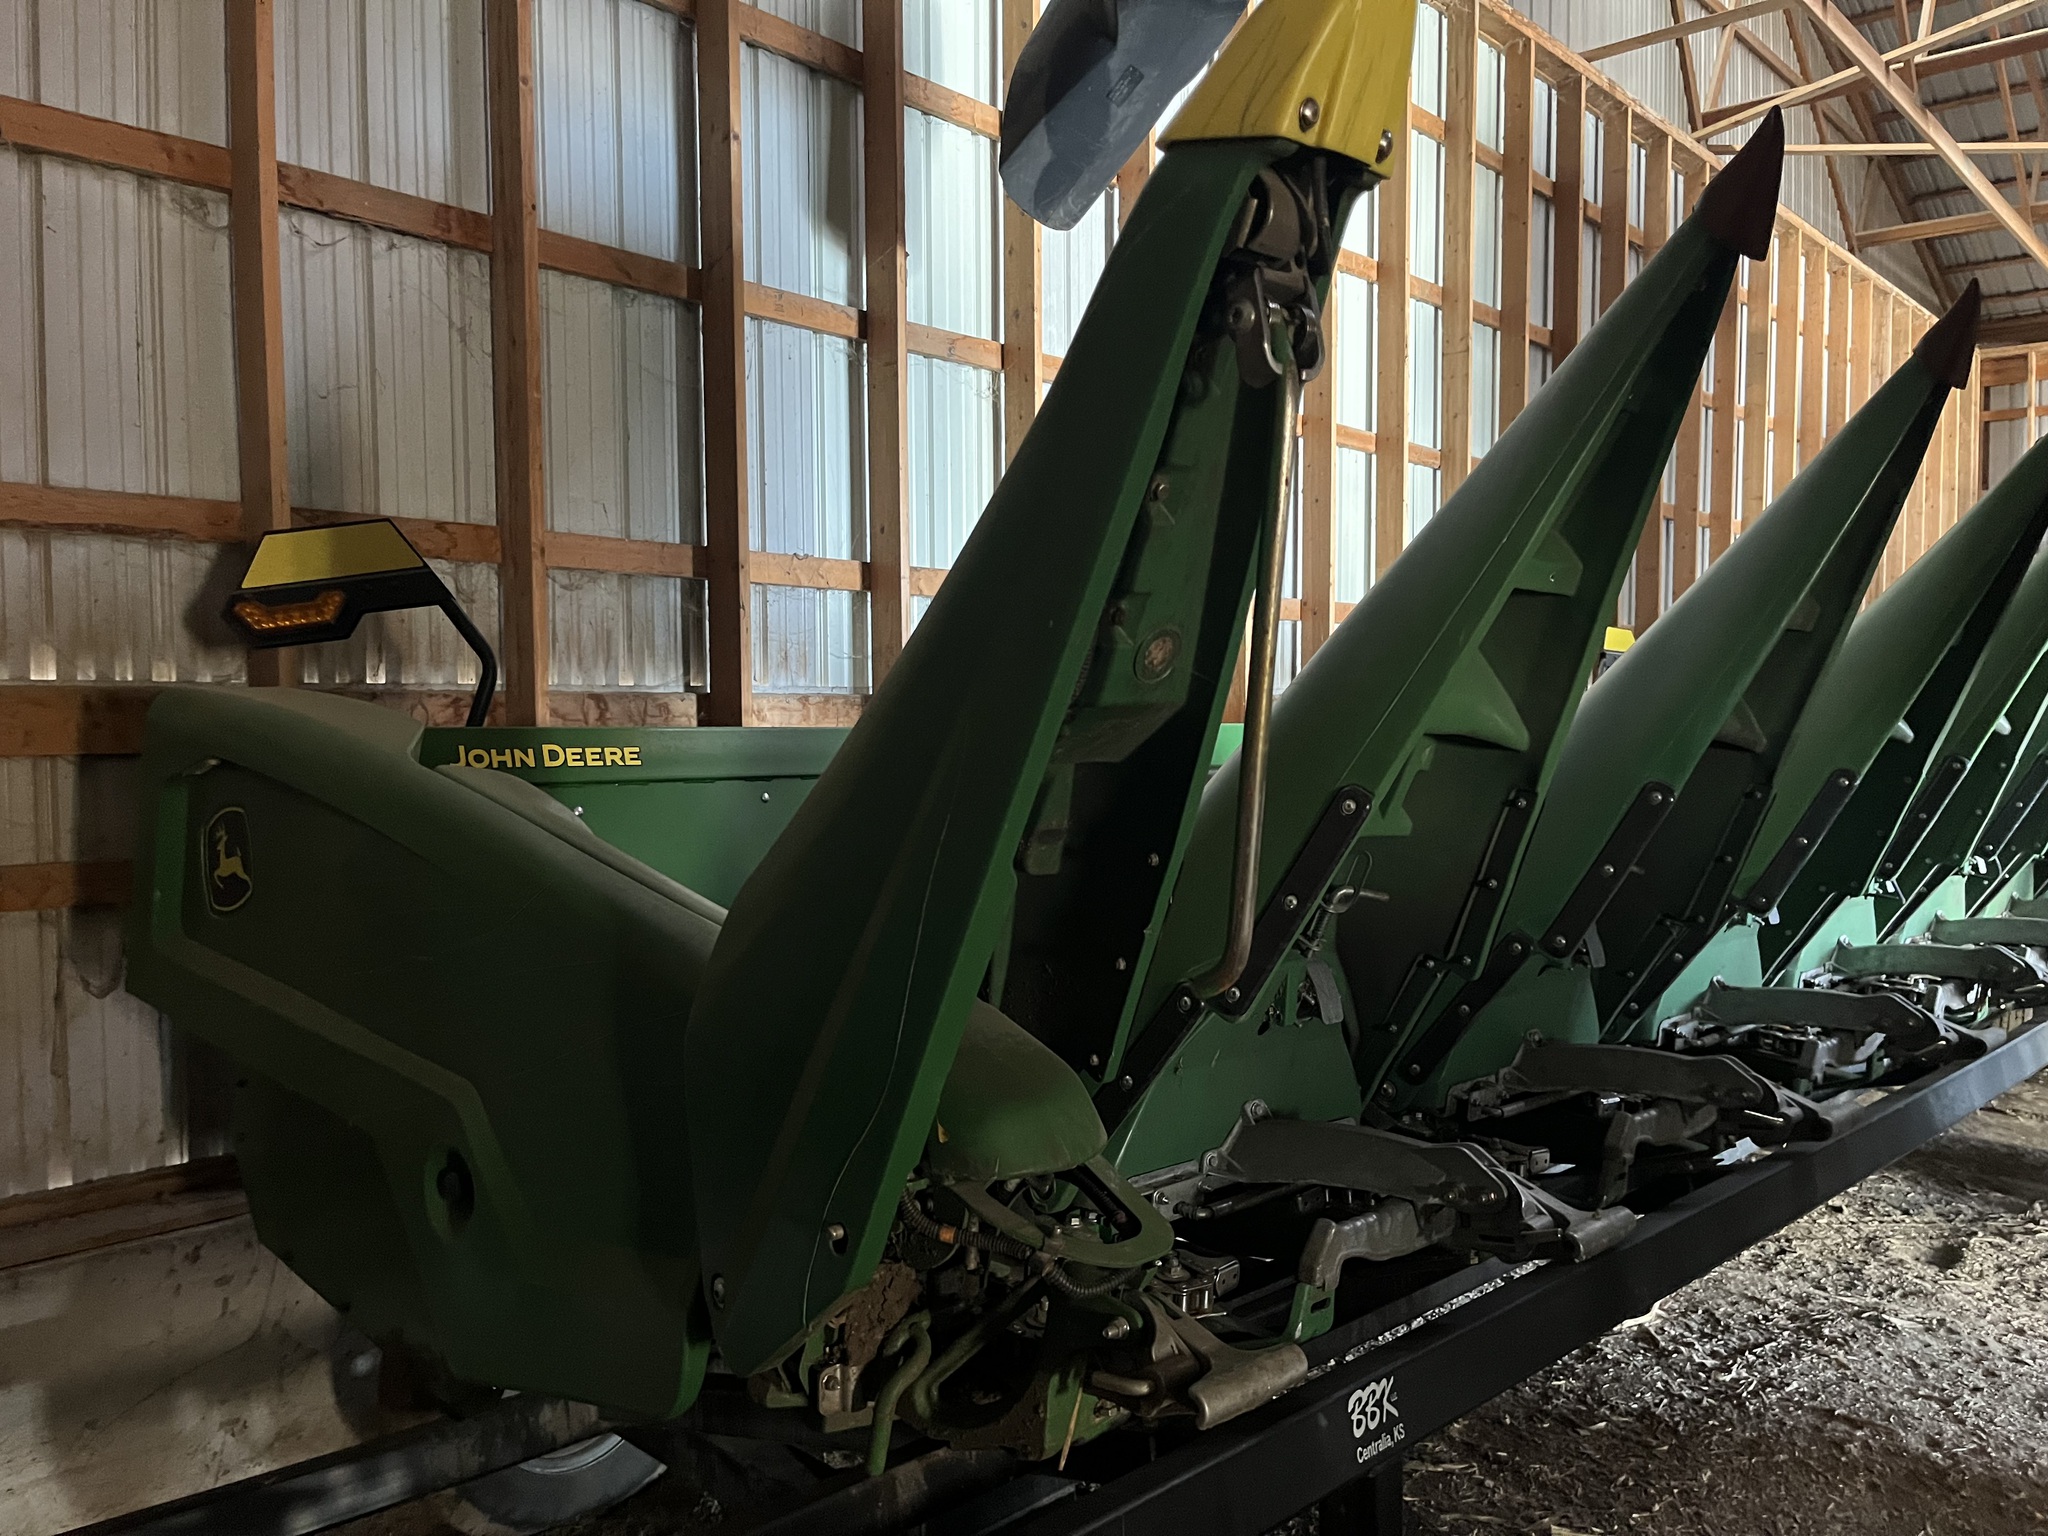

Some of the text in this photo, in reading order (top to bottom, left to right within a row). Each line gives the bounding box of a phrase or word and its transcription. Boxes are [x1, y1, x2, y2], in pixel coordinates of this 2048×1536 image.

[449, 743, 642, 769] JOHN DEERE
[1356, 1422, 1406, 1464] Centralia, KS
